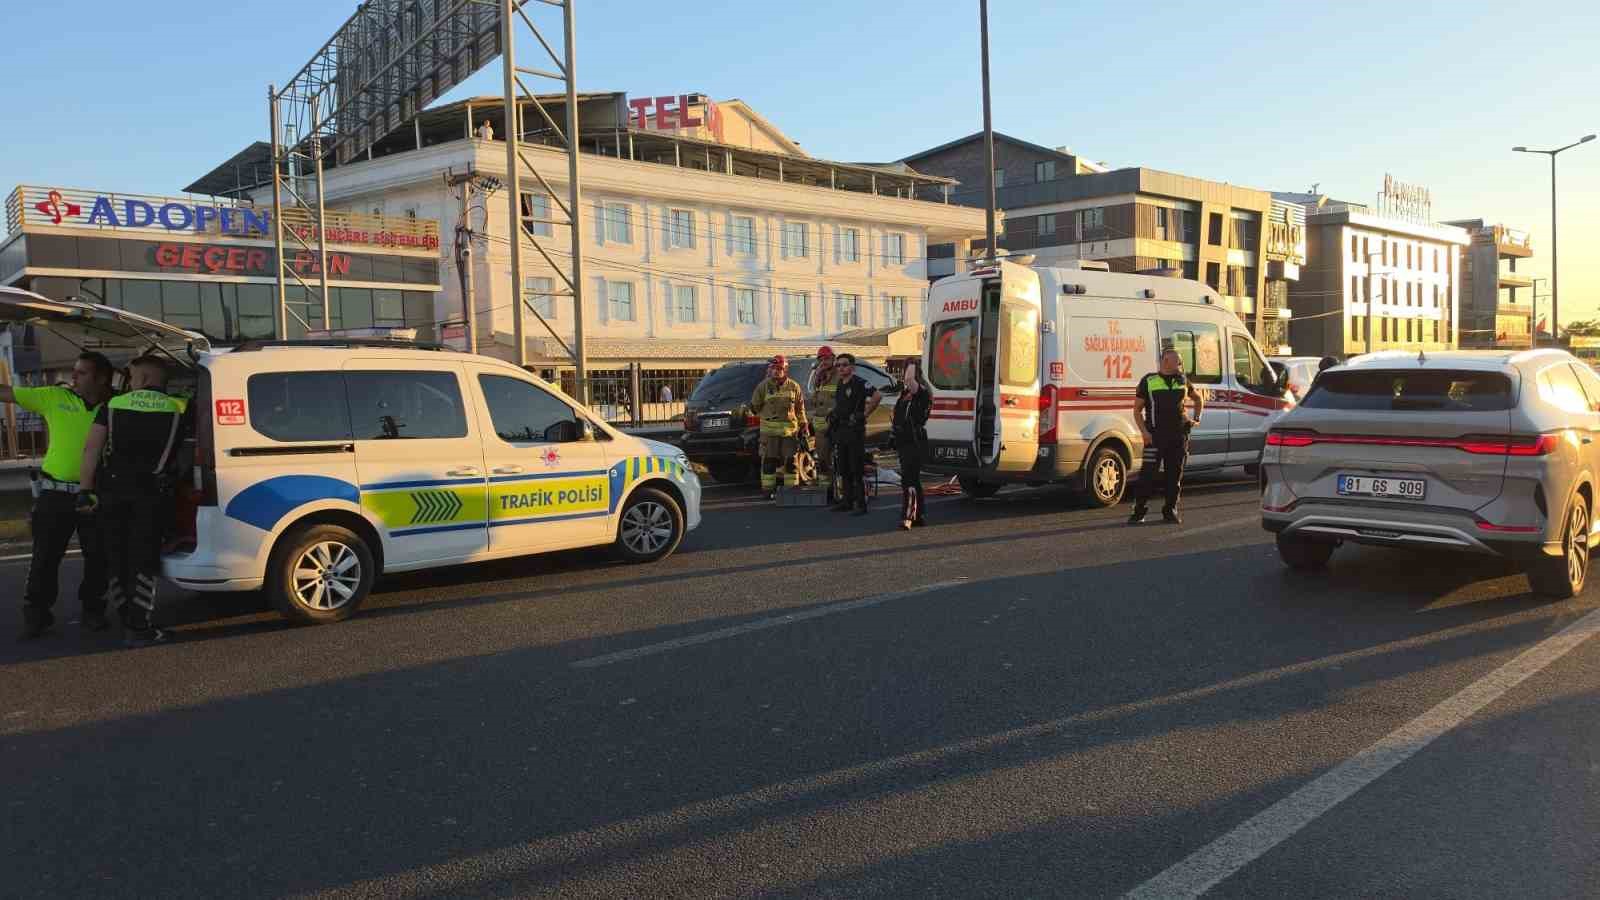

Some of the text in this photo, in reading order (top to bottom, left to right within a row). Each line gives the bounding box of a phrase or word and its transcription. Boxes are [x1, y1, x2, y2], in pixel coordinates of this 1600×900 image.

[627, 94, 702, 130] TEL
[87, 195, 270, 237] ADOPEN
[154, 242, 268, 273] GEÇER
[942, 299, 978, 312] AMBU
[1103, 354, 1132, 379] 112
[219, 401, 243, 415] 112
[500, 484, 603, 510] TRAFİK POLİSİ
[1346, 478, 1422, 495] 81 GS 909
